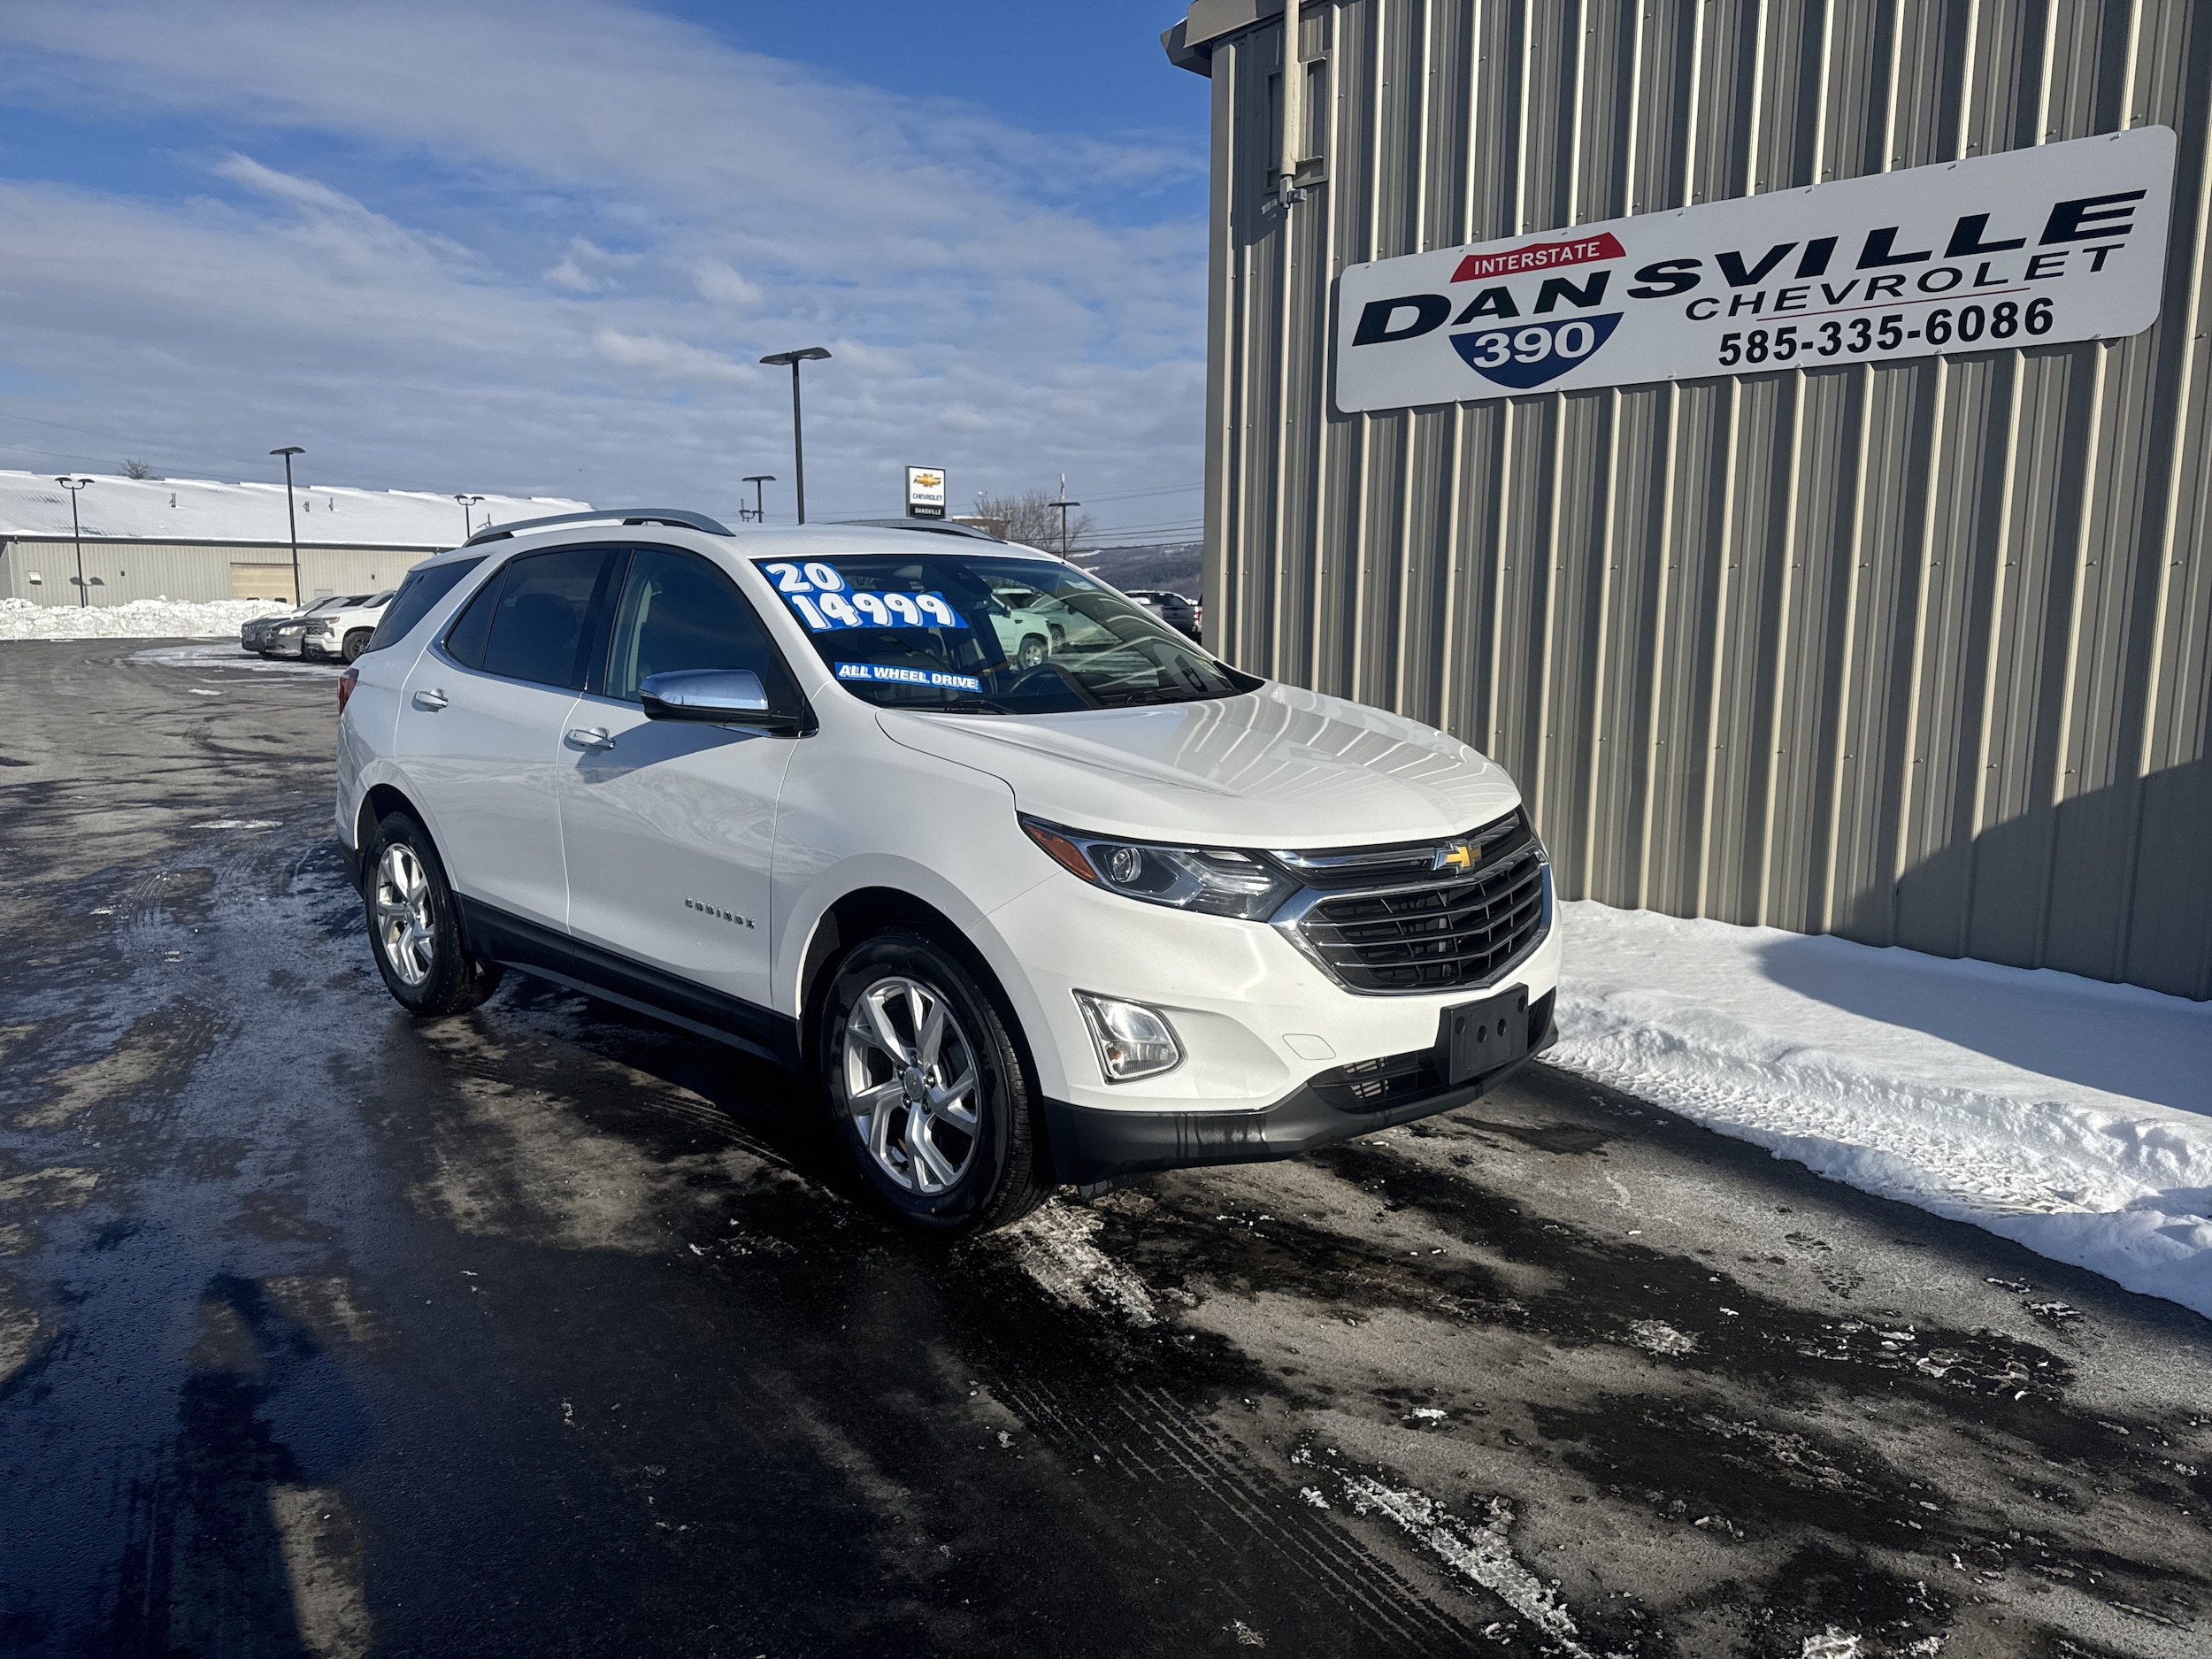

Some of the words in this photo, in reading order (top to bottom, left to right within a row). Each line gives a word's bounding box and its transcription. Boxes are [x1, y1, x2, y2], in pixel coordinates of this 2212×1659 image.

[1473, 241, 1601, 276] INTERSTATE
[1685, 243, 2125, 321] CHEVROLET
[1471, 319, 1596, 368] 390
[1718, 296, 2055, 366] 585-335-6086
[765, 563, 845, 592] 20
[791, 592, 956, 630] 14999
[838, 664, 872, 679] ALL
[873, 666, 930, 684] WHEEL
[932, 672, 979, 690] DRIVE
[685, 897, 755, 929] EQUINOX
